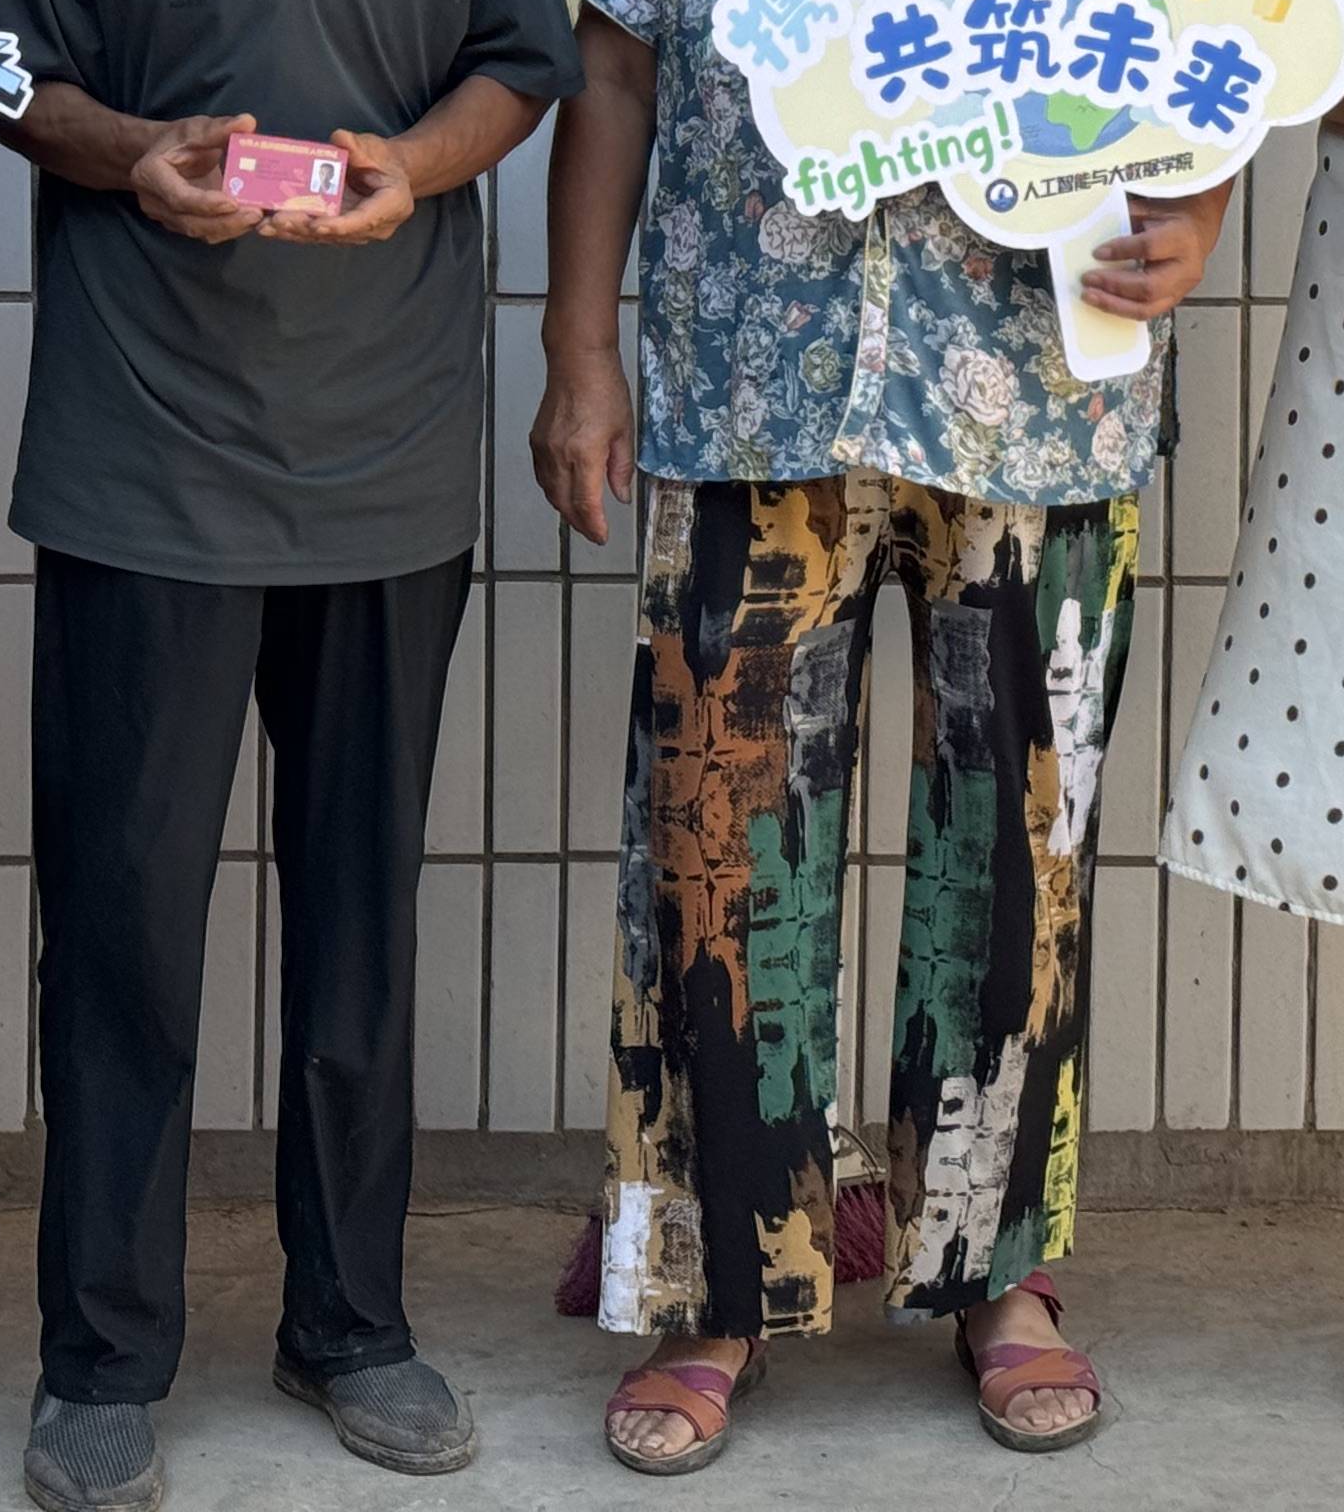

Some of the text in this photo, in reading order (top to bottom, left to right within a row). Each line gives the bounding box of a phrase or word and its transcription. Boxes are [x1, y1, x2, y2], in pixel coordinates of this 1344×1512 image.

[793, 101, 1014, 210] fighting!
[1023, 152, 1194, 201] 人工智能与大数据学院
